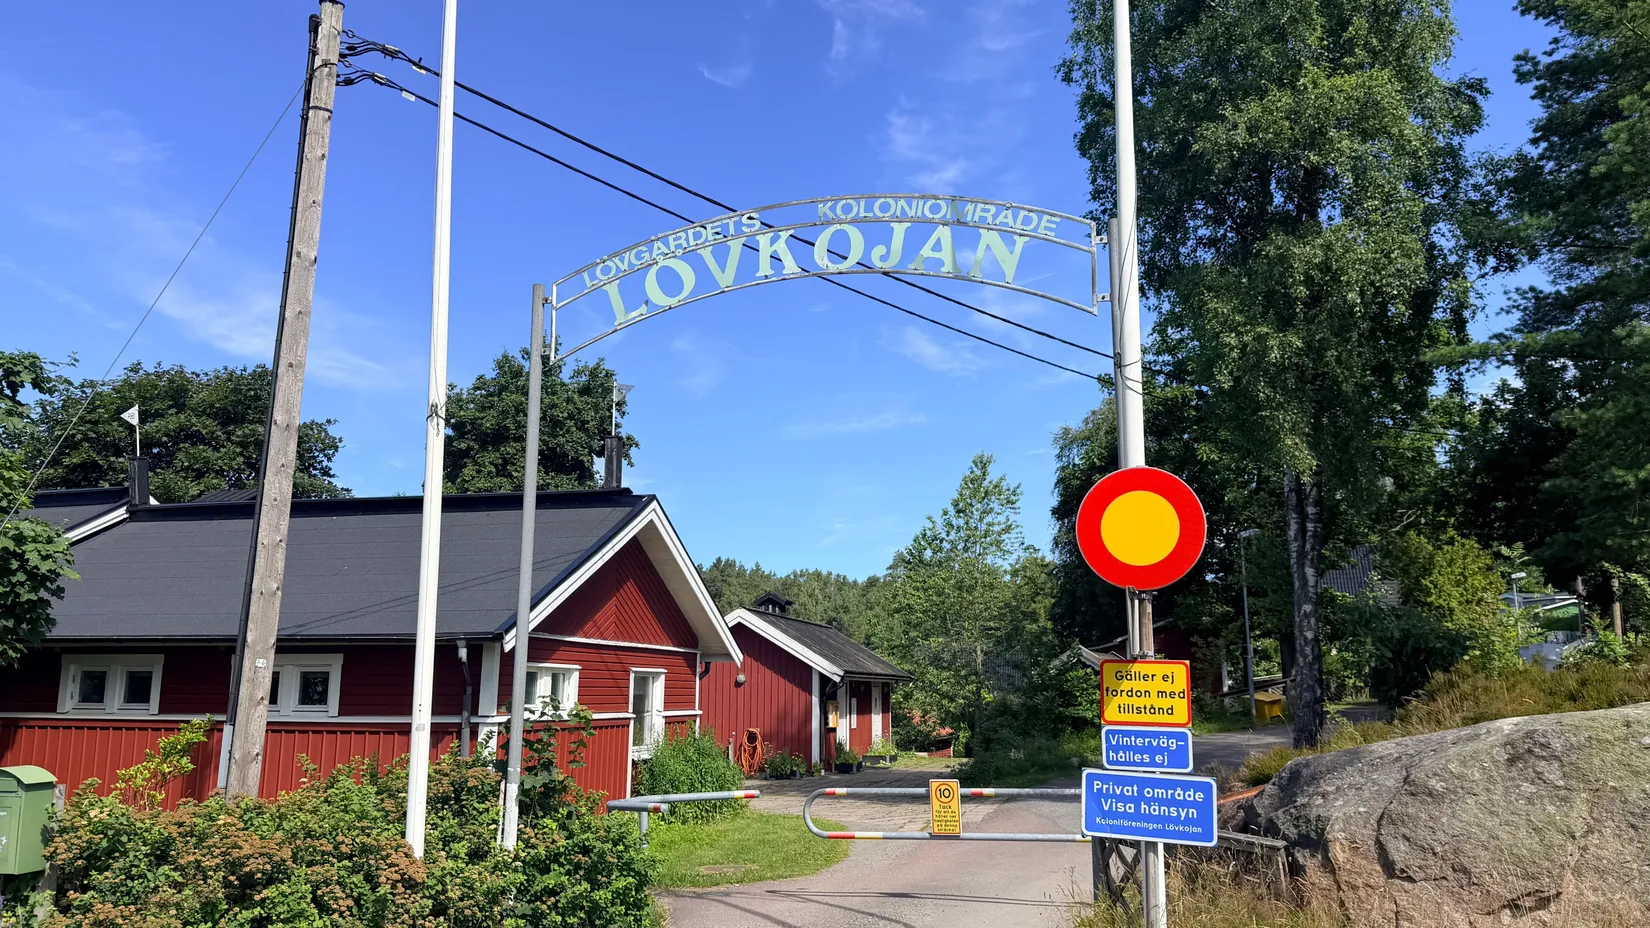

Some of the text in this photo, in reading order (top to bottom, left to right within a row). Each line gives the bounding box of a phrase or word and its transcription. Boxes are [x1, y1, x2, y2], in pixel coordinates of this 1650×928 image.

[582, 198, 1061, 288] LÖVGÄRDETS KOLONIOMRÅDE
[602, 221, 1029, 326] LÖVKOJAN
[1115, 670, 1175, 685] Gäller ej
[1105, 686, 1186, 700] fordon med
[1117, 703, 1174, 716] tillstånd
[1109, 733, 1185, 750] Vinterväg-
[1109, 750, 1168, 766] hålles ej
[938, 788, 951, 798] 10
[1093, 780, 1205, 802] Privat område
[1101, 797, 1197, 820] Visa hänsyn
[1095, 816, 1203, 834] Koloniföreningen Lövkojan
